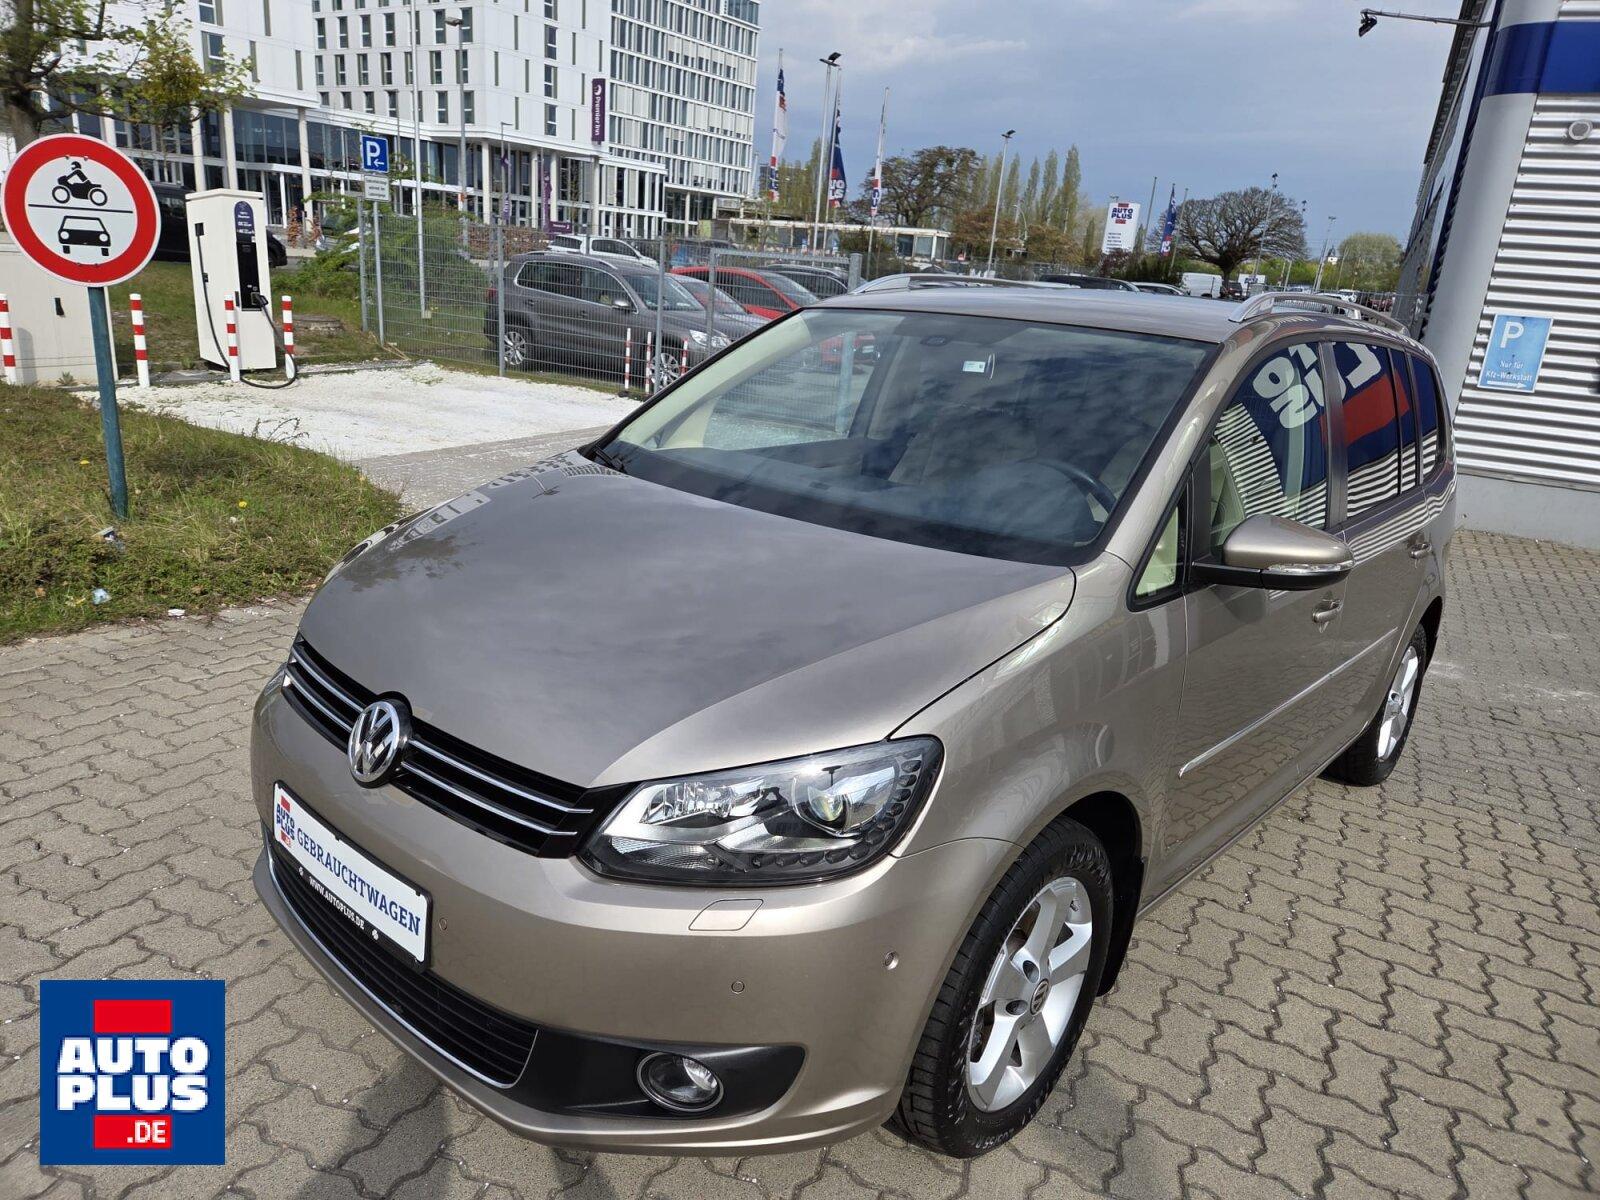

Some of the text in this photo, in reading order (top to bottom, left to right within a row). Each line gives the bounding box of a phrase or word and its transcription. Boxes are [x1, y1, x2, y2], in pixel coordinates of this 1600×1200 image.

[366, 140, 381, 166] P
[1111, 212, 1133, 220] PLUS
[1500, 321, 1525, 349] P
[1485, 371, 1533, 382] Kfz-Werkstatt
[1500, 360, 1525, 369] Nur für
[276, 803, 295, 829] AUTO
[276, 814, 295, 840] PLUS
[296, 827, 421, 936] GEBRAUCHTWAGEN
[309, 876, 365, 930] WWW.AUTOPLUS.DE
